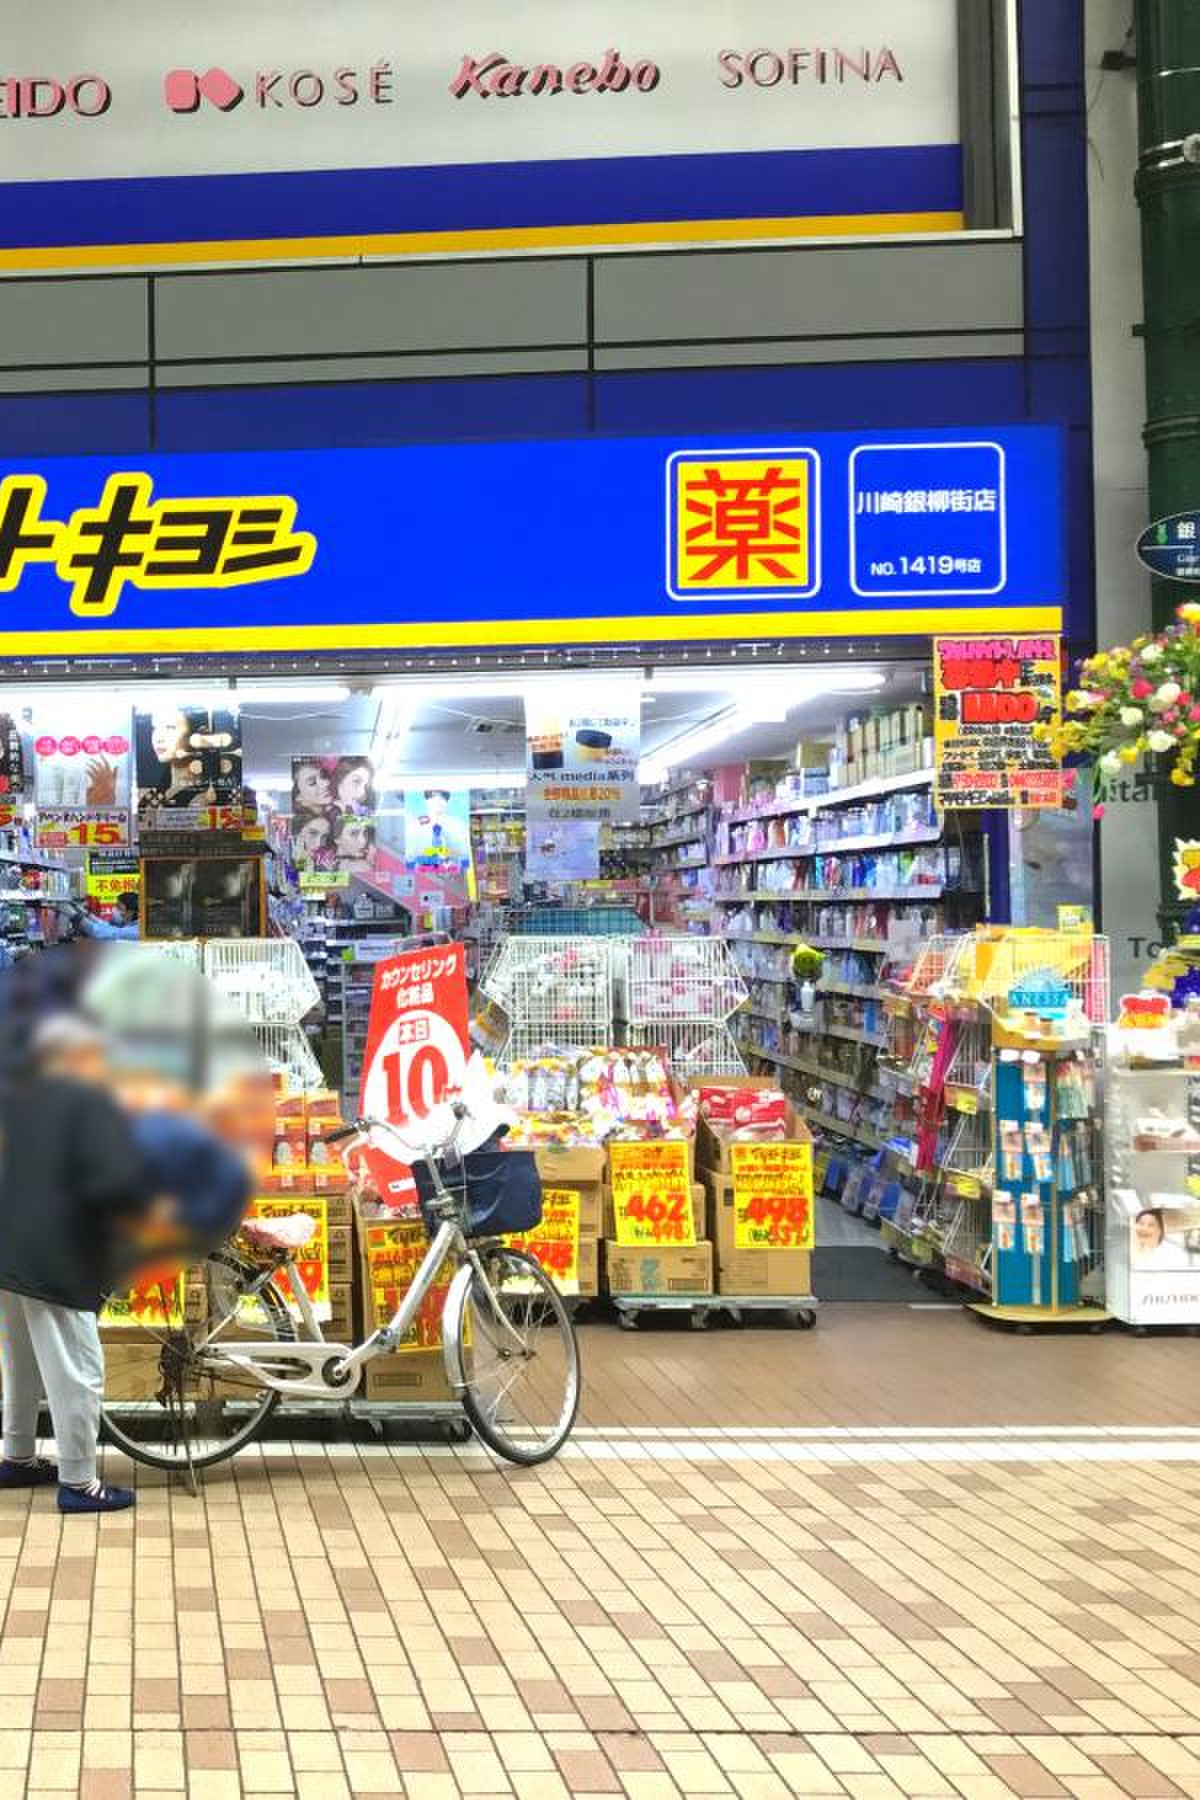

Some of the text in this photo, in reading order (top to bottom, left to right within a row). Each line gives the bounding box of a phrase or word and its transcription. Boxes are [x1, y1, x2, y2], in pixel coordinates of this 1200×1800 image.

[253, 60, 394, 108] KOSÉ
[448, 46, 660, 99] Kanebo
[717, 45, 905, 88] SOFINA
[856, 488, 997, 515] 川崎銀柳街店
[685, 467, 800, 581] 薬
[379, 953, 458, 990] カウンセリング
[397, 981, 435, 1009] 化粧品
[400, 1018, 429, 1043] 本日
